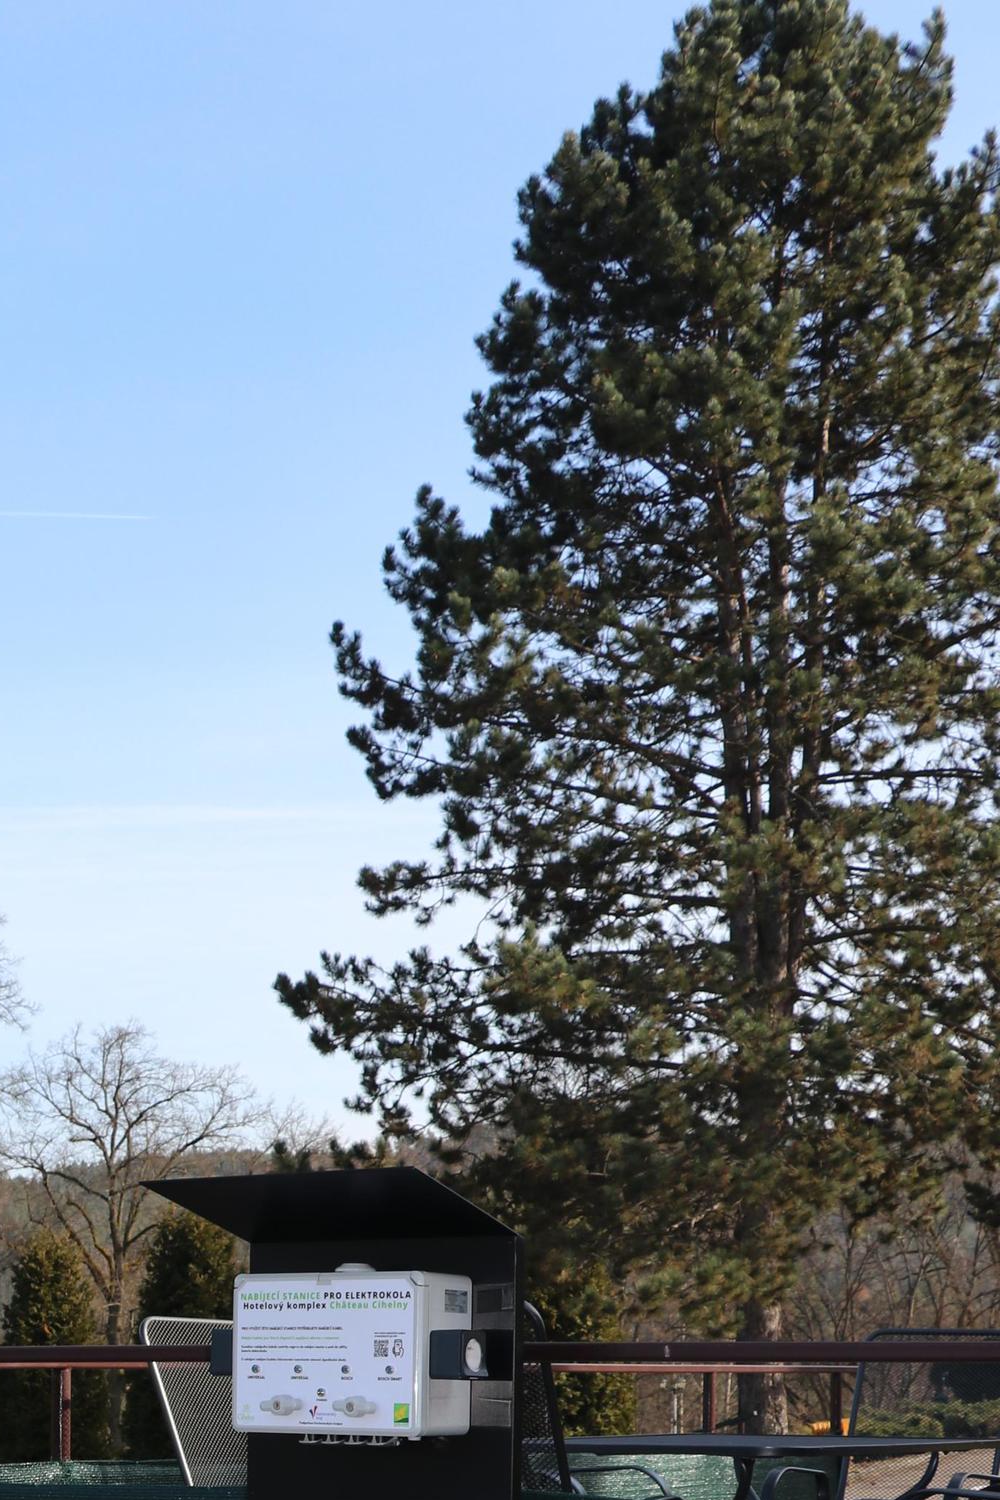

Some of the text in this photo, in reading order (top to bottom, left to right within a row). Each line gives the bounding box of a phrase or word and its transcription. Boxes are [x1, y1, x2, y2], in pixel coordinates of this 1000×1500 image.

[241, 1290, 411, 1301] NABÍJECÍ STANICE PRO ELEKTROKOLA
[243, 1301, 284, 1311] Hotelový
[287, 1301, 327, 1311] komplex
[329, 1300, 369, 1310] Château
